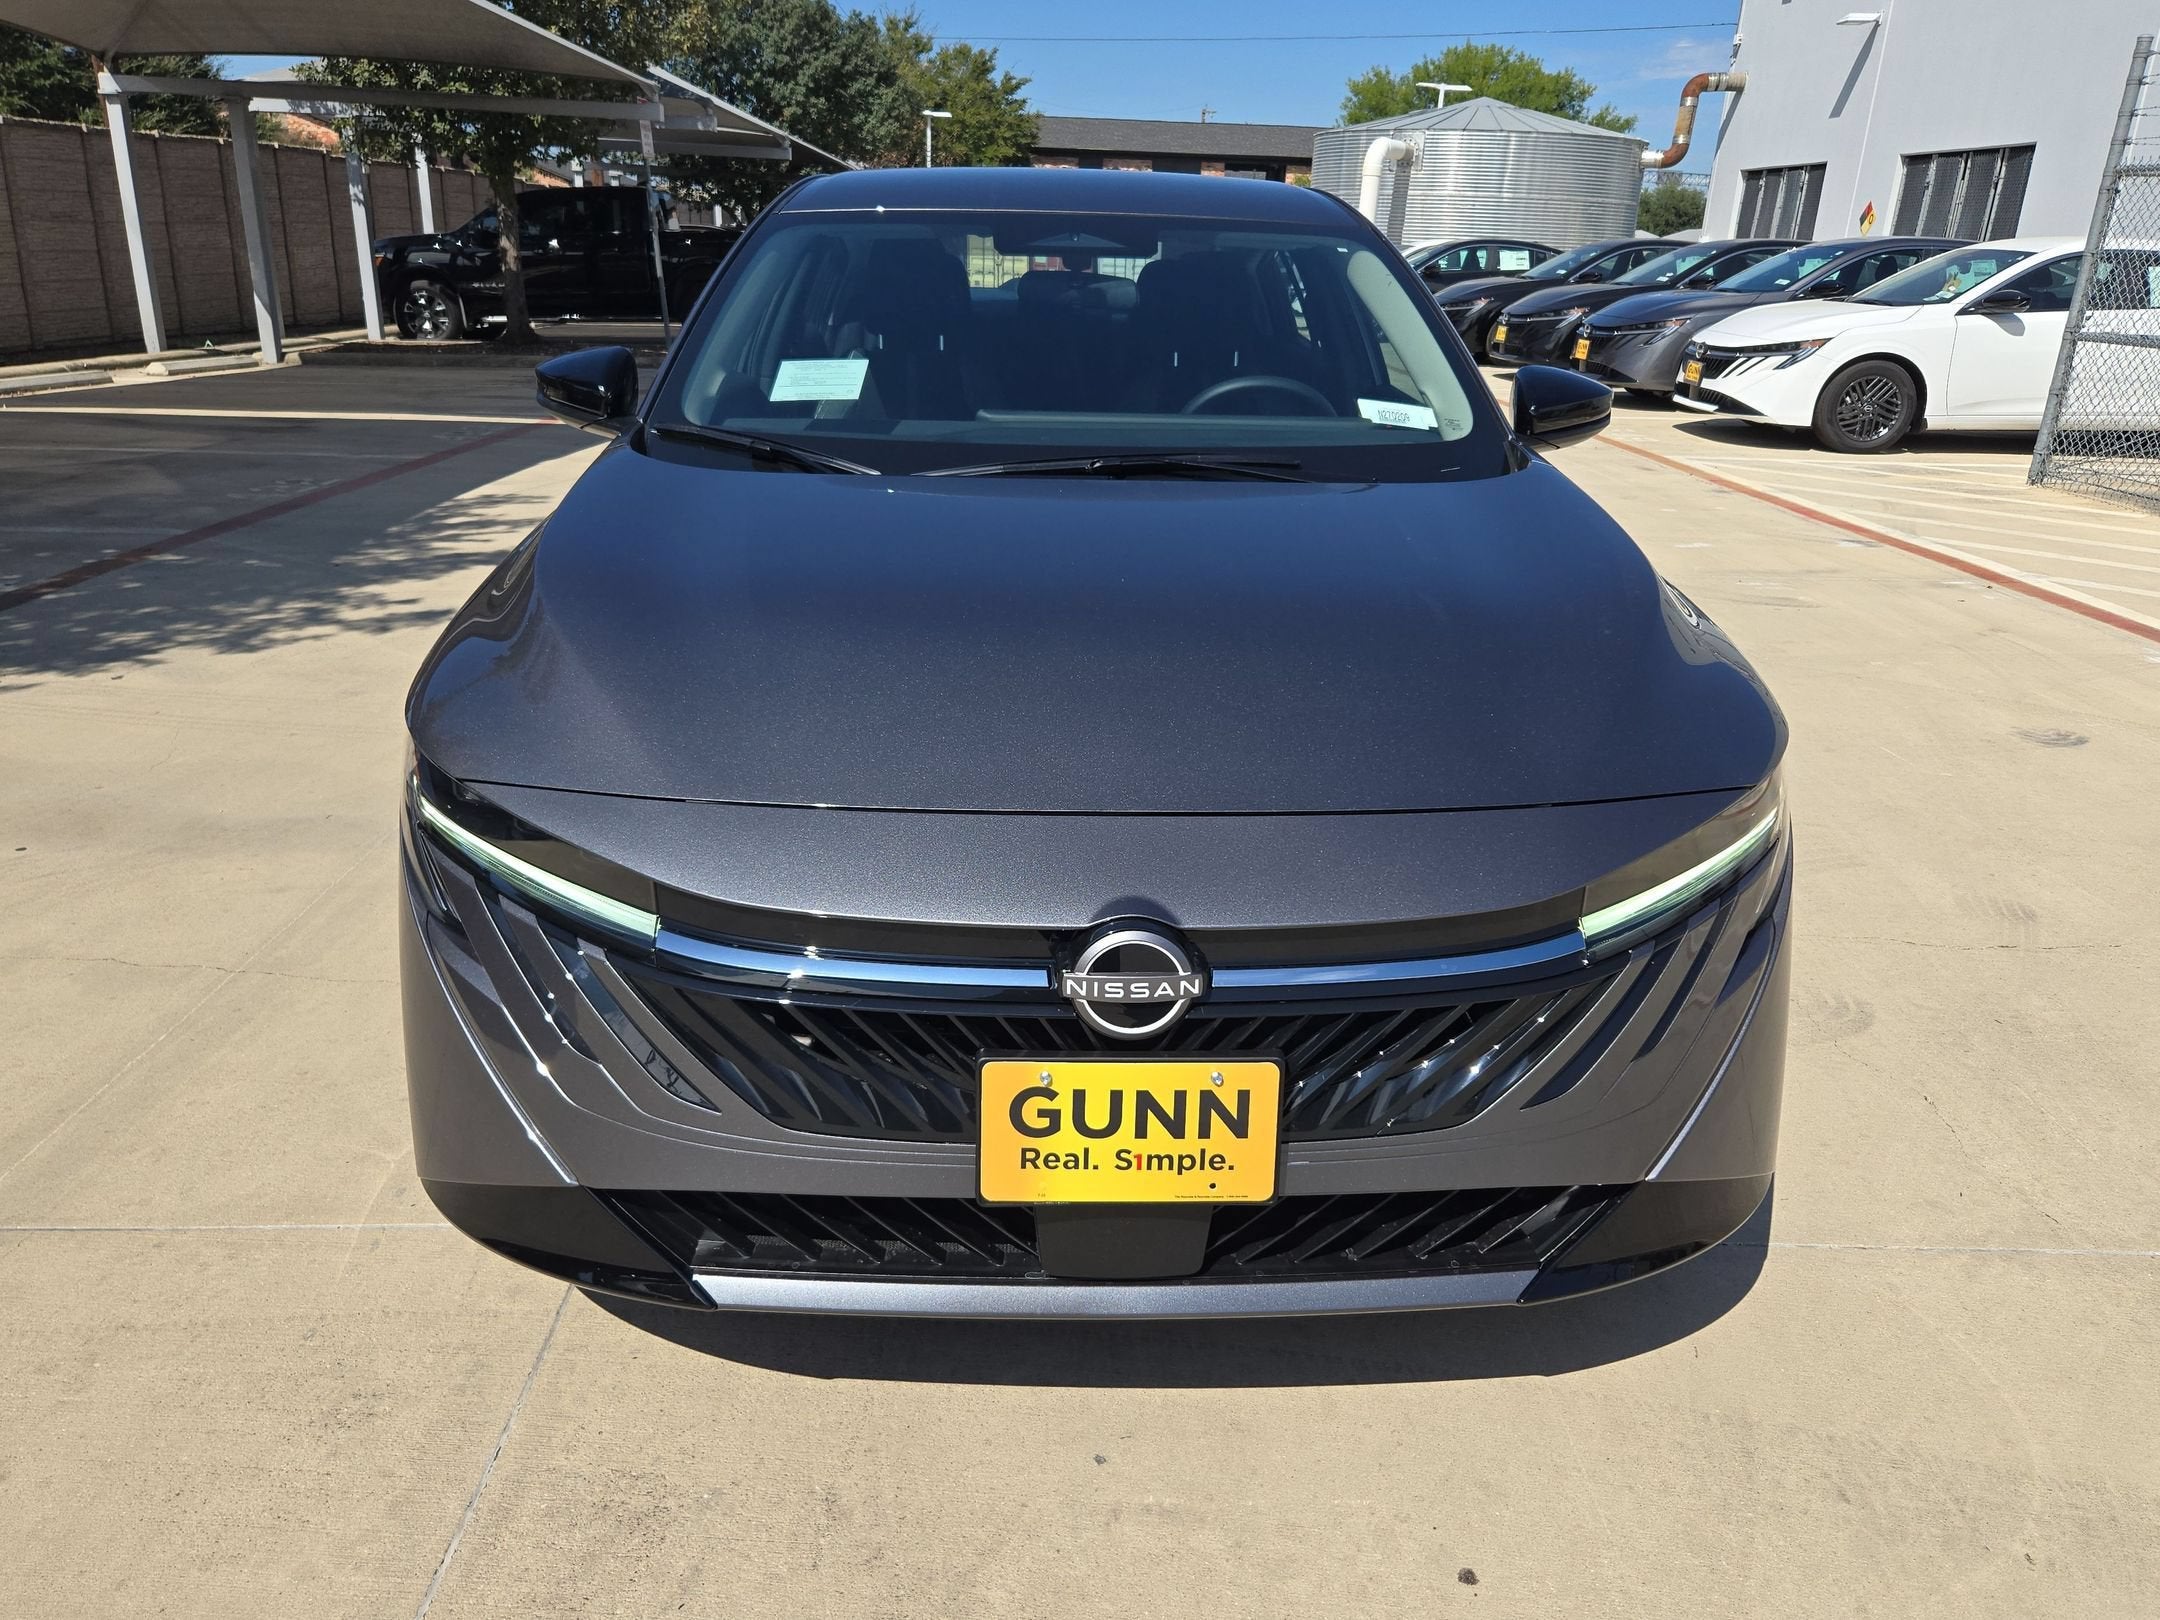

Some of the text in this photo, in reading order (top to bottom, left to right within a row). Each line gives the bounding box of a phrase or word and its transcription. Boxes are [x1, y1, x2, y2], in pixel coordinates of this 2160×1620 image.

[1065, 978, 1200, 999] NISSAN
[1009, 1086, 1251, 1140] GUNN
[1020, 1147, 1235, 1176] Real. S1mple.
